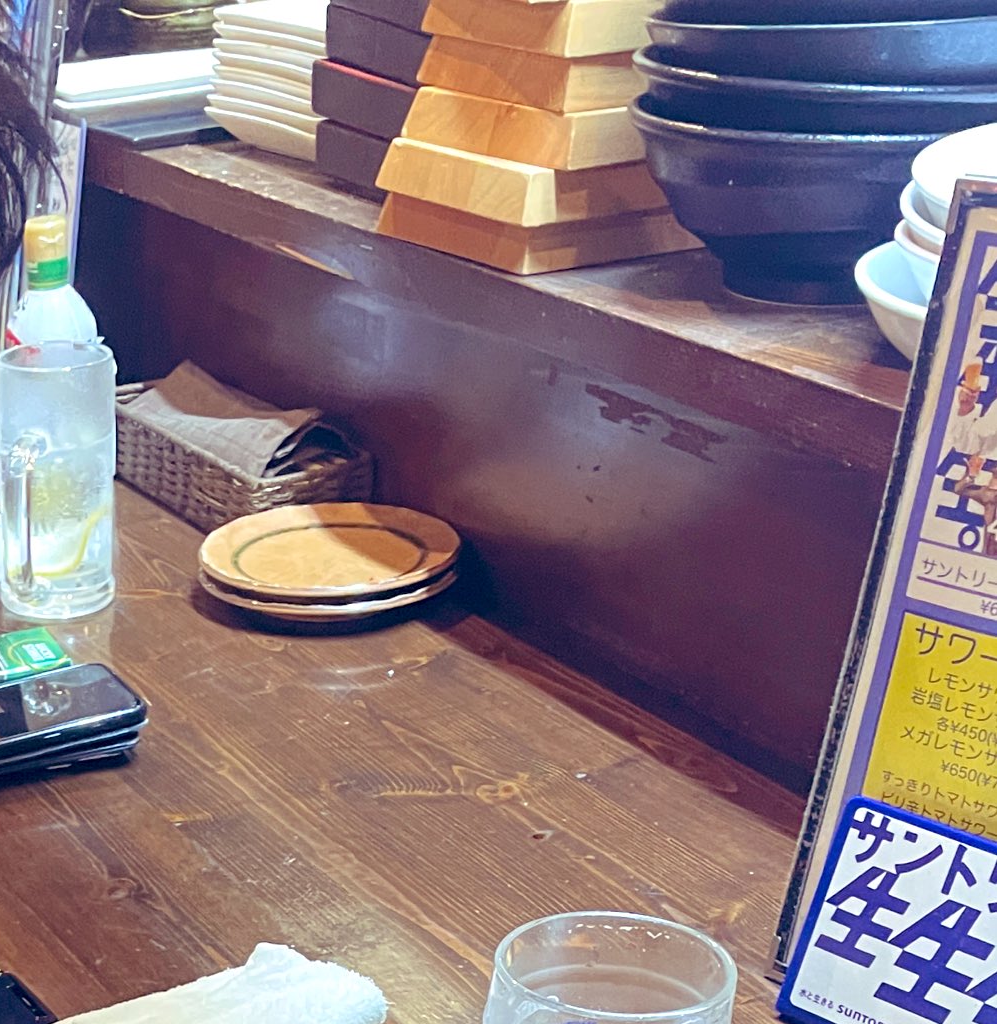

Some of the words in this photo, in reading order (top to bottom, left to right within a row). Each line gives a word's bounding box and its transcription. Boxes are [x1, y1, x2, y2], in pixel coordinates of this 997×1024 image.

[928, 667, 997, 699] レモンサ
[911, 686, 997, 722] 岩塩レモン
[853, 811, 997, 912] サント
